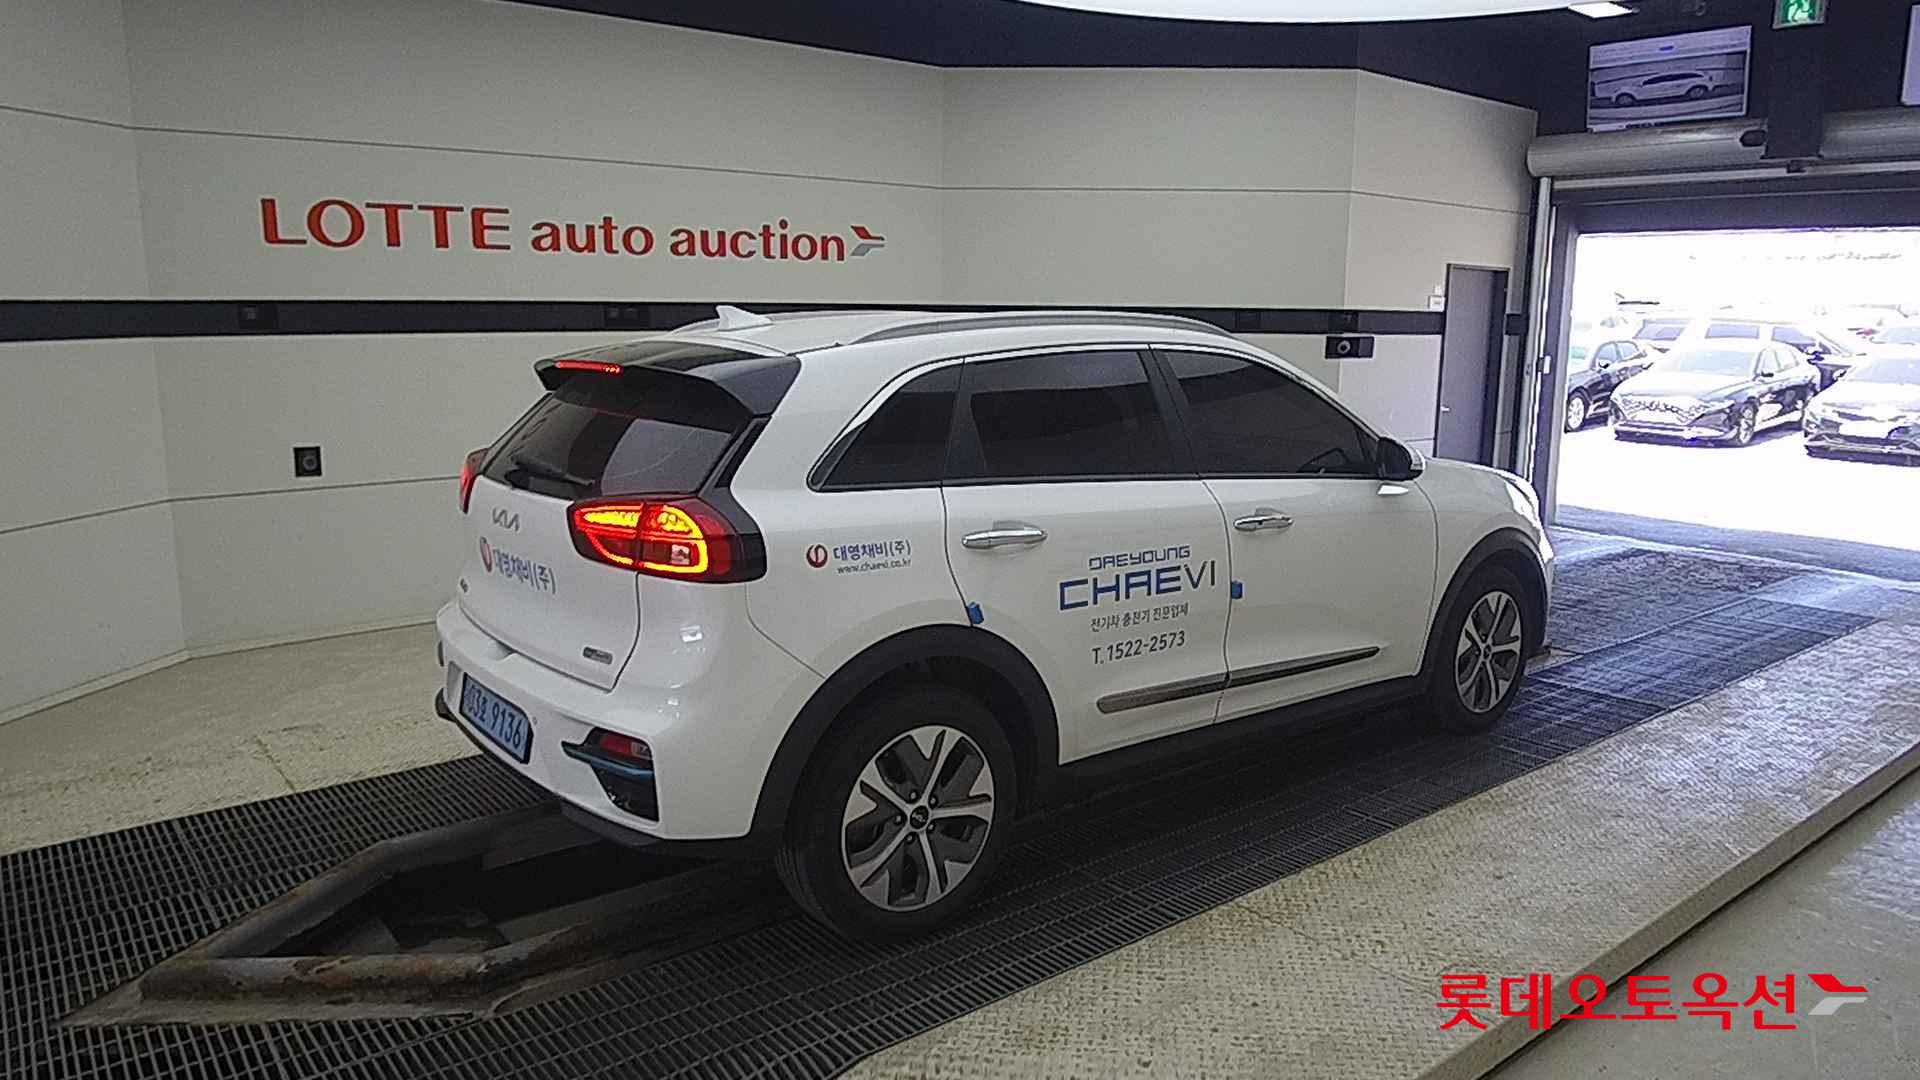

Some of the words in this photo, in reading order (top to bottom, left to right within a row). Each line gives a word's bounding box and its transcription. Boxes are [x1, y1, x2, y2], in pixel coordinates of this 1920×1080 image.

[261, 198, 511, 250] LOTTE
[531, 215, 655, 258] auto
[670, 219, 845, 262] auction
[832, 539, 911, 561] 대영채비(주)
[1089, 546, 1191, 570] DAEYOUNG
[1059, 560, 1216, 611] CHAEVI
[491, 702, 524, 749] 9136
